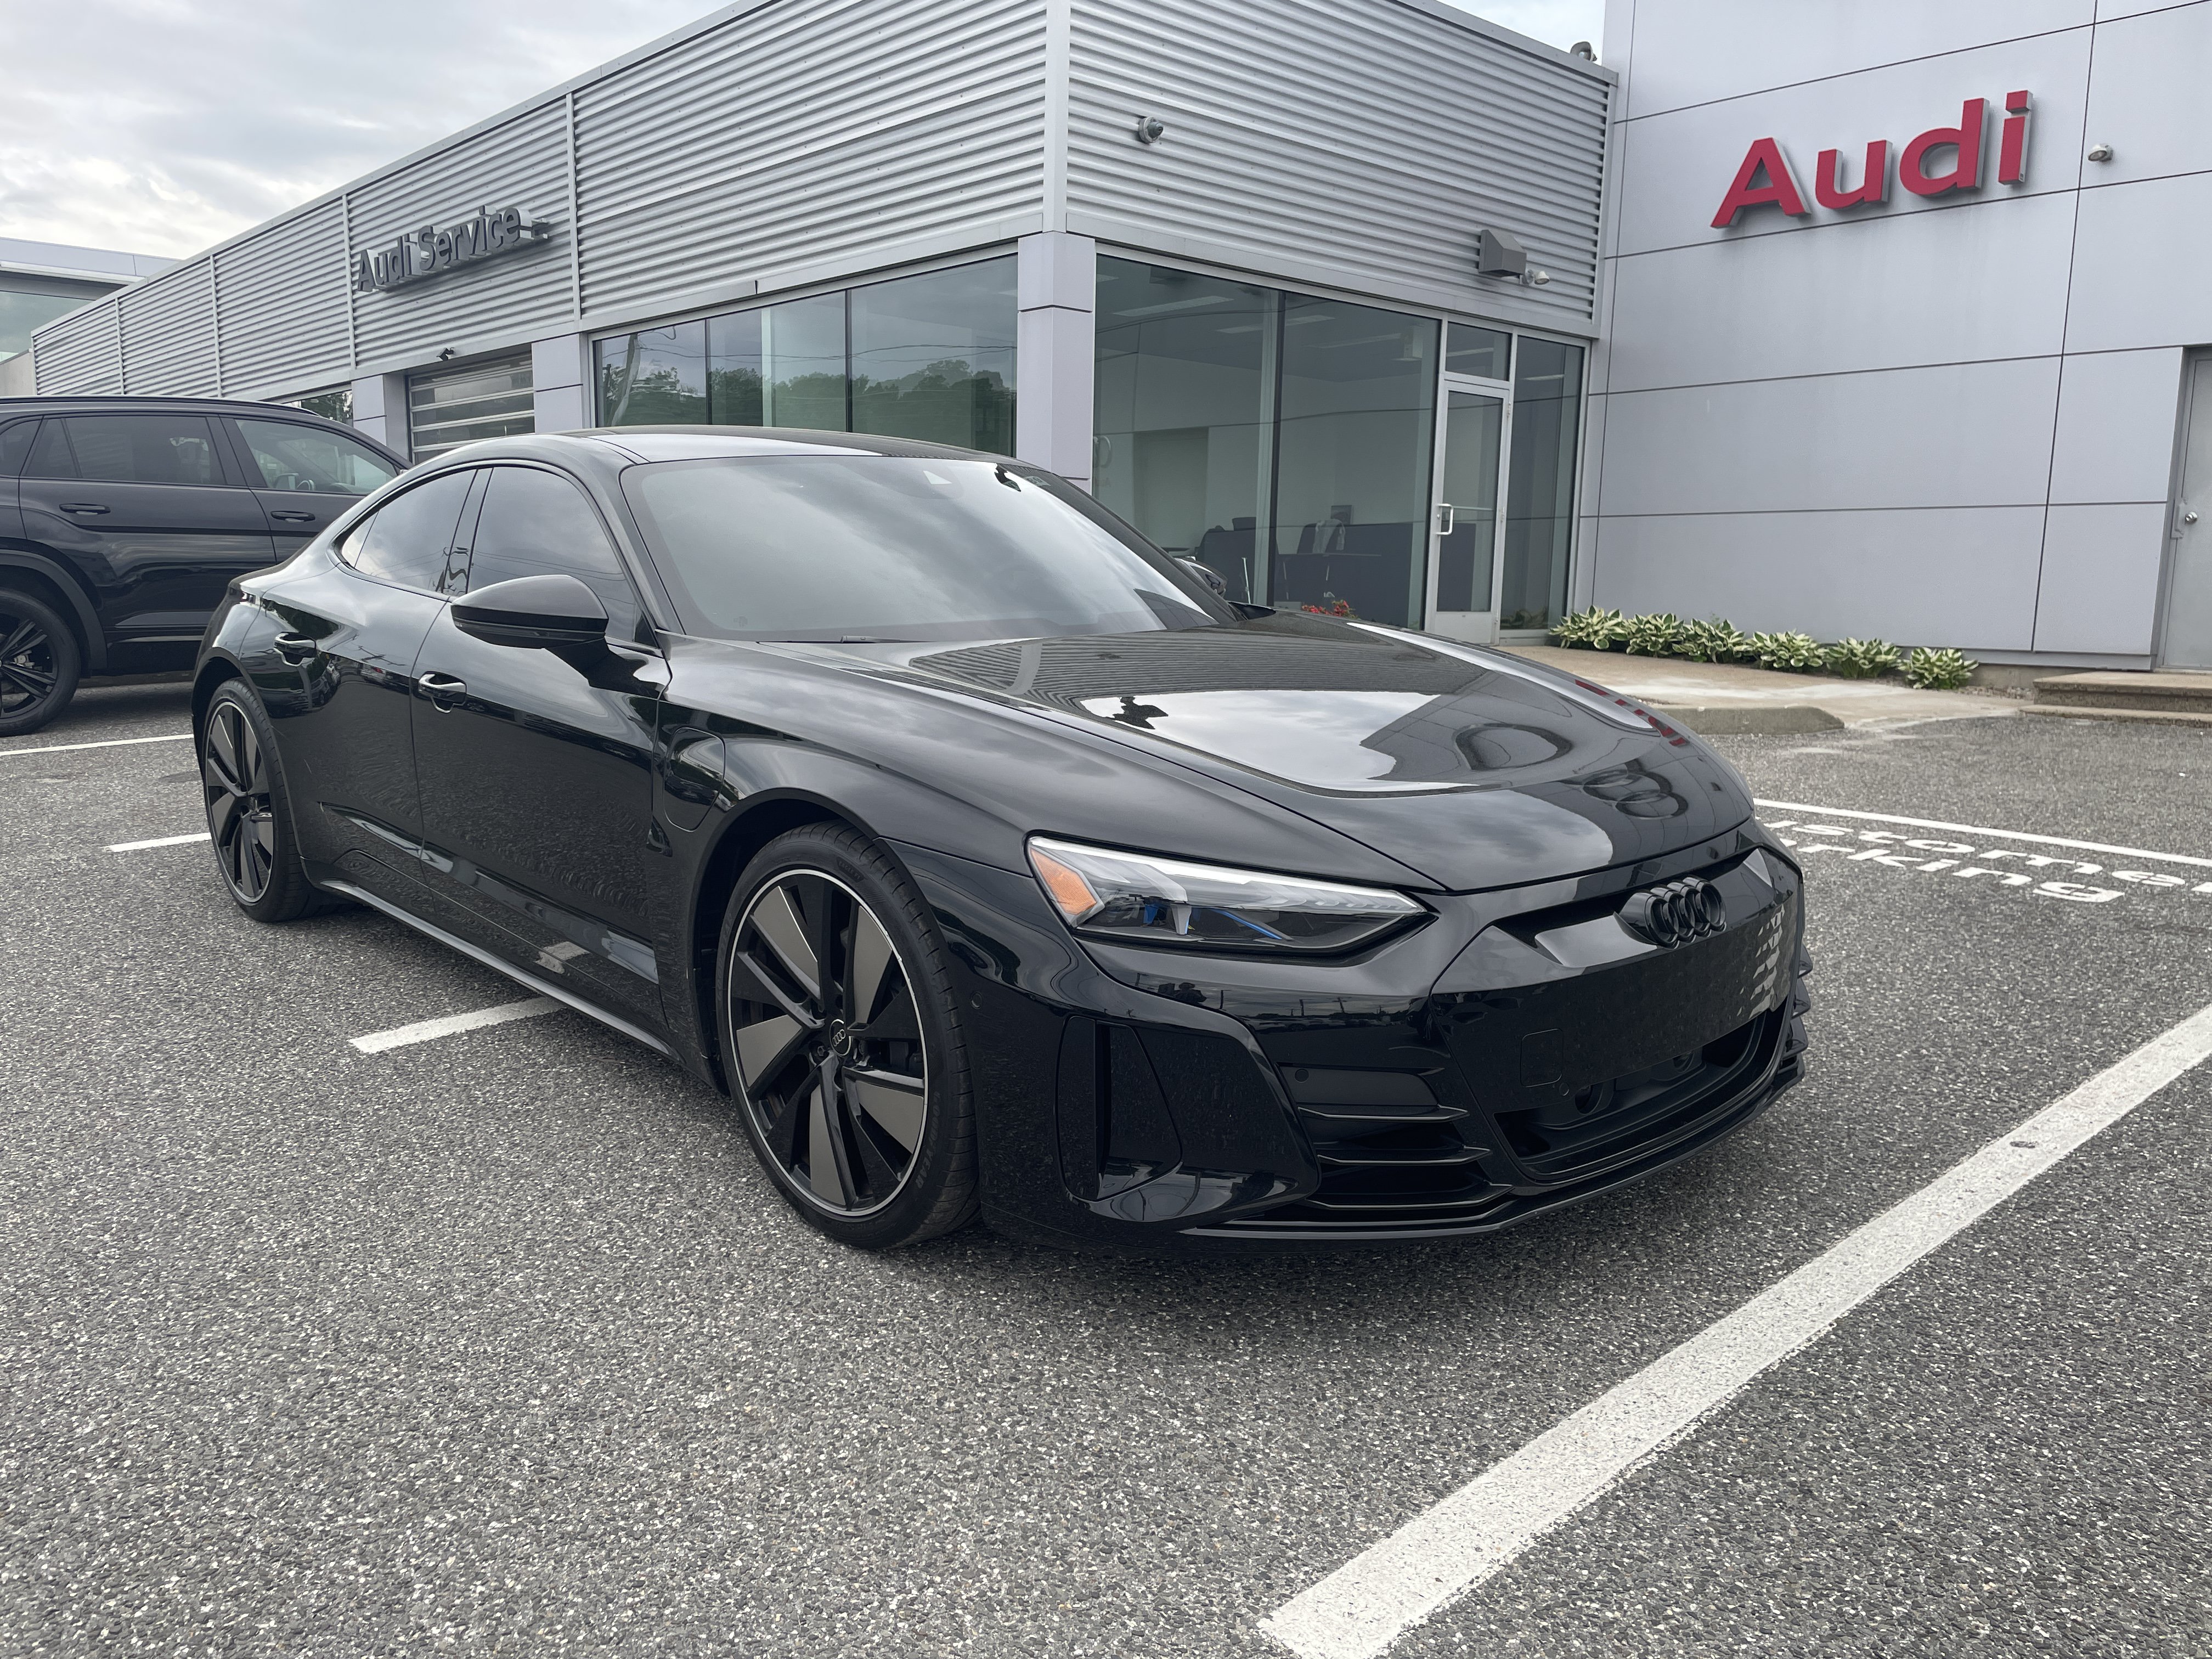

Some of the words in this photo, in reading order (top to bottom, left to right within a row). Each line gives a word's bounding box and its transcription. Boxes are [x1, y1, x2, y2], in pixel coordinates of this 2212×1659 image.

[1711, 89, 2032, 228] Audi
[357, 233, 414, 292] Audi
[419, 205, 527, 271] Service
[1755, 816, 2212, 894] stome
[1779, 838, 2125, 902] rking
